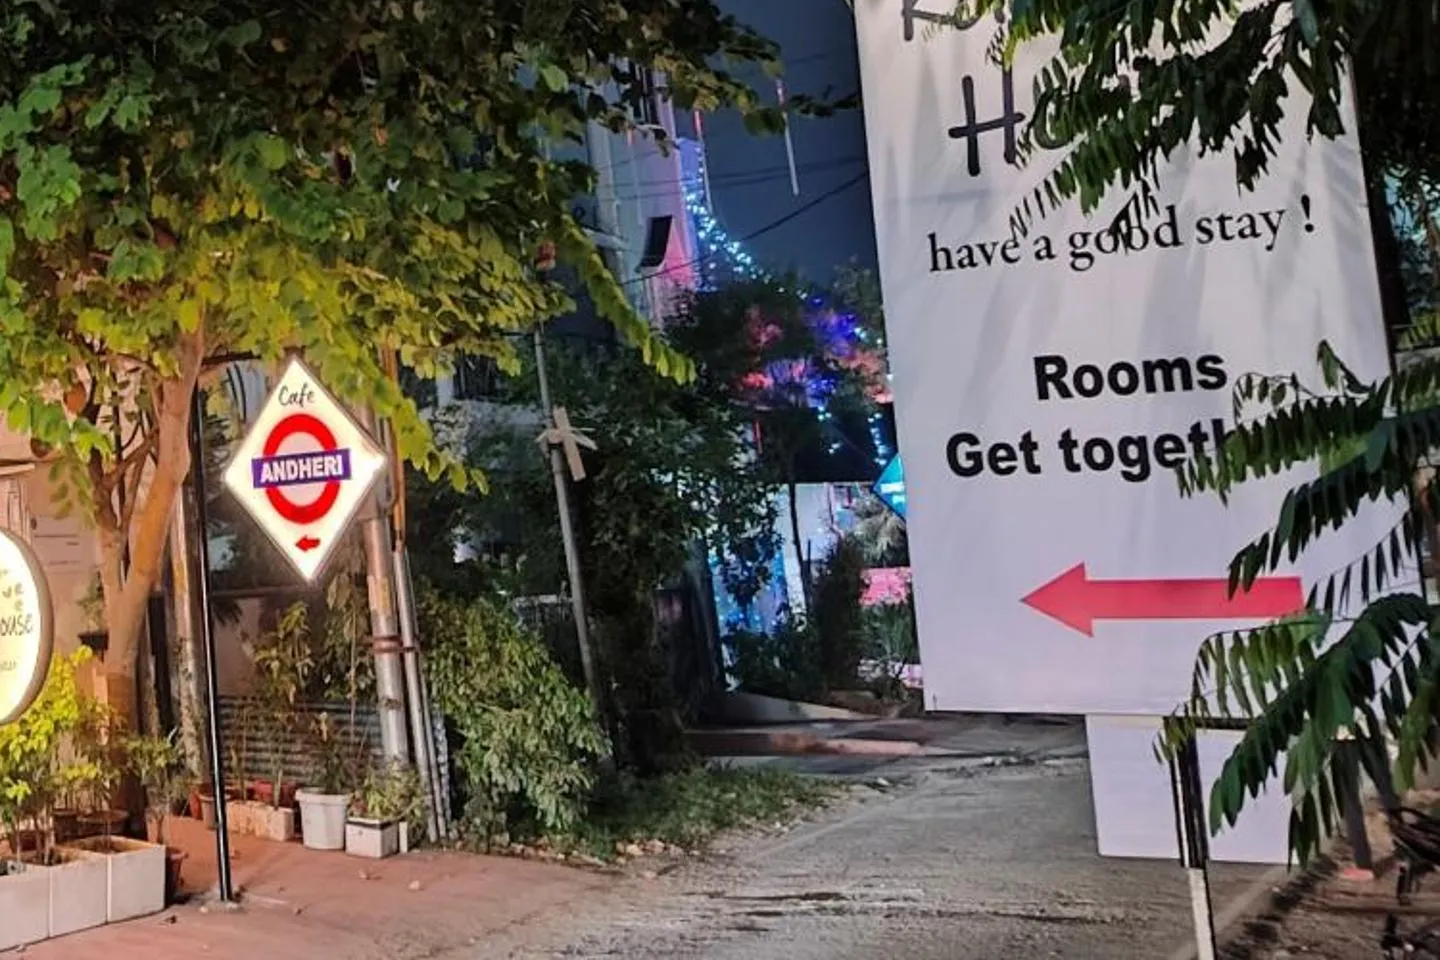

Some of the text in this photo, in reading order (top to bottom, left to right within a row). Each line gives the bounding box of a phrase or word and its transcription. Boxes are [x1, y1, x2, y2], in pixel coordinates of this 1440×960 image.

[927, 232, 1021, 273] have
[1034, 234, 1056, 262] a
[1068, 204, 1185, 272] good
[1195, 208, 1286, 253] stay
[278, 383, 316, 408] Cafe
[1032, 353, 1228, 400] Rooms
[260, 454, 344, 483] ANDHERI
[945, 431, 1042, 478] Get
